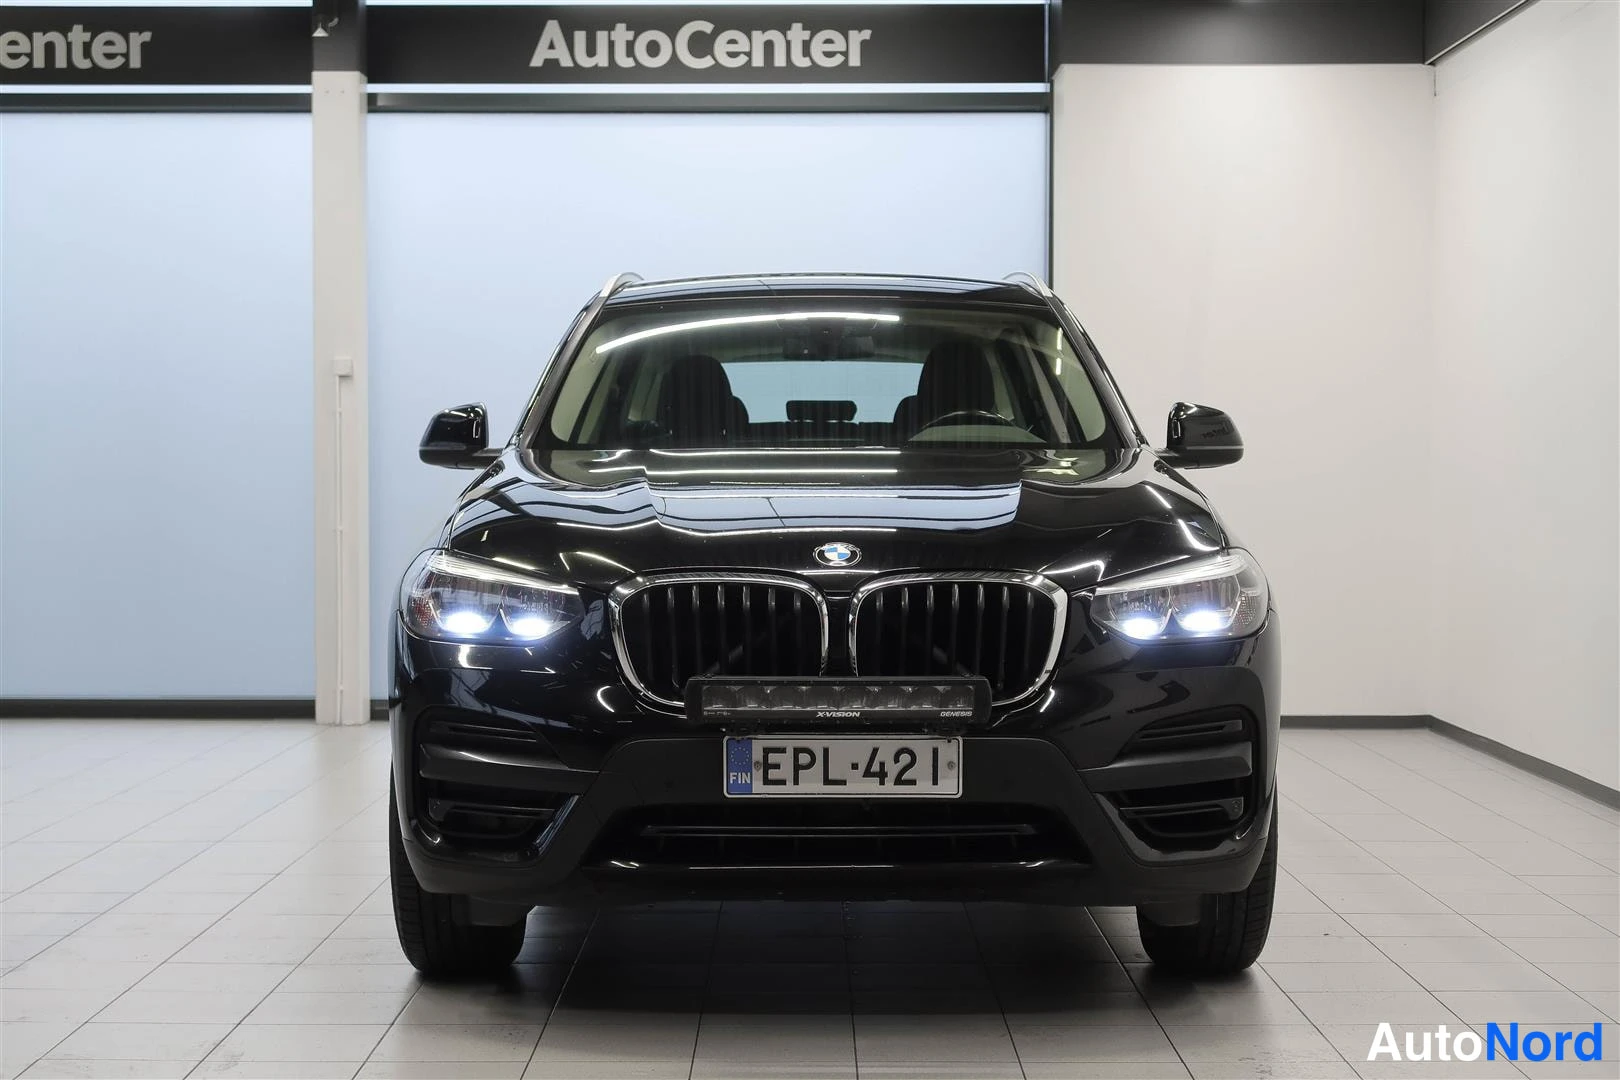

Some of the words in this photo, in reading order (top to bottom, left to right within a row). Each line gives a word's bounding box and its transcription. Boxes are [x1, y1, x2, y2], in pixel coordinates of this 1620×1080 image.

[0, 25, 152, 69] enter
[529, 19, 872, 69] AutoCenter
[729, 772, 751, 784] FIN
